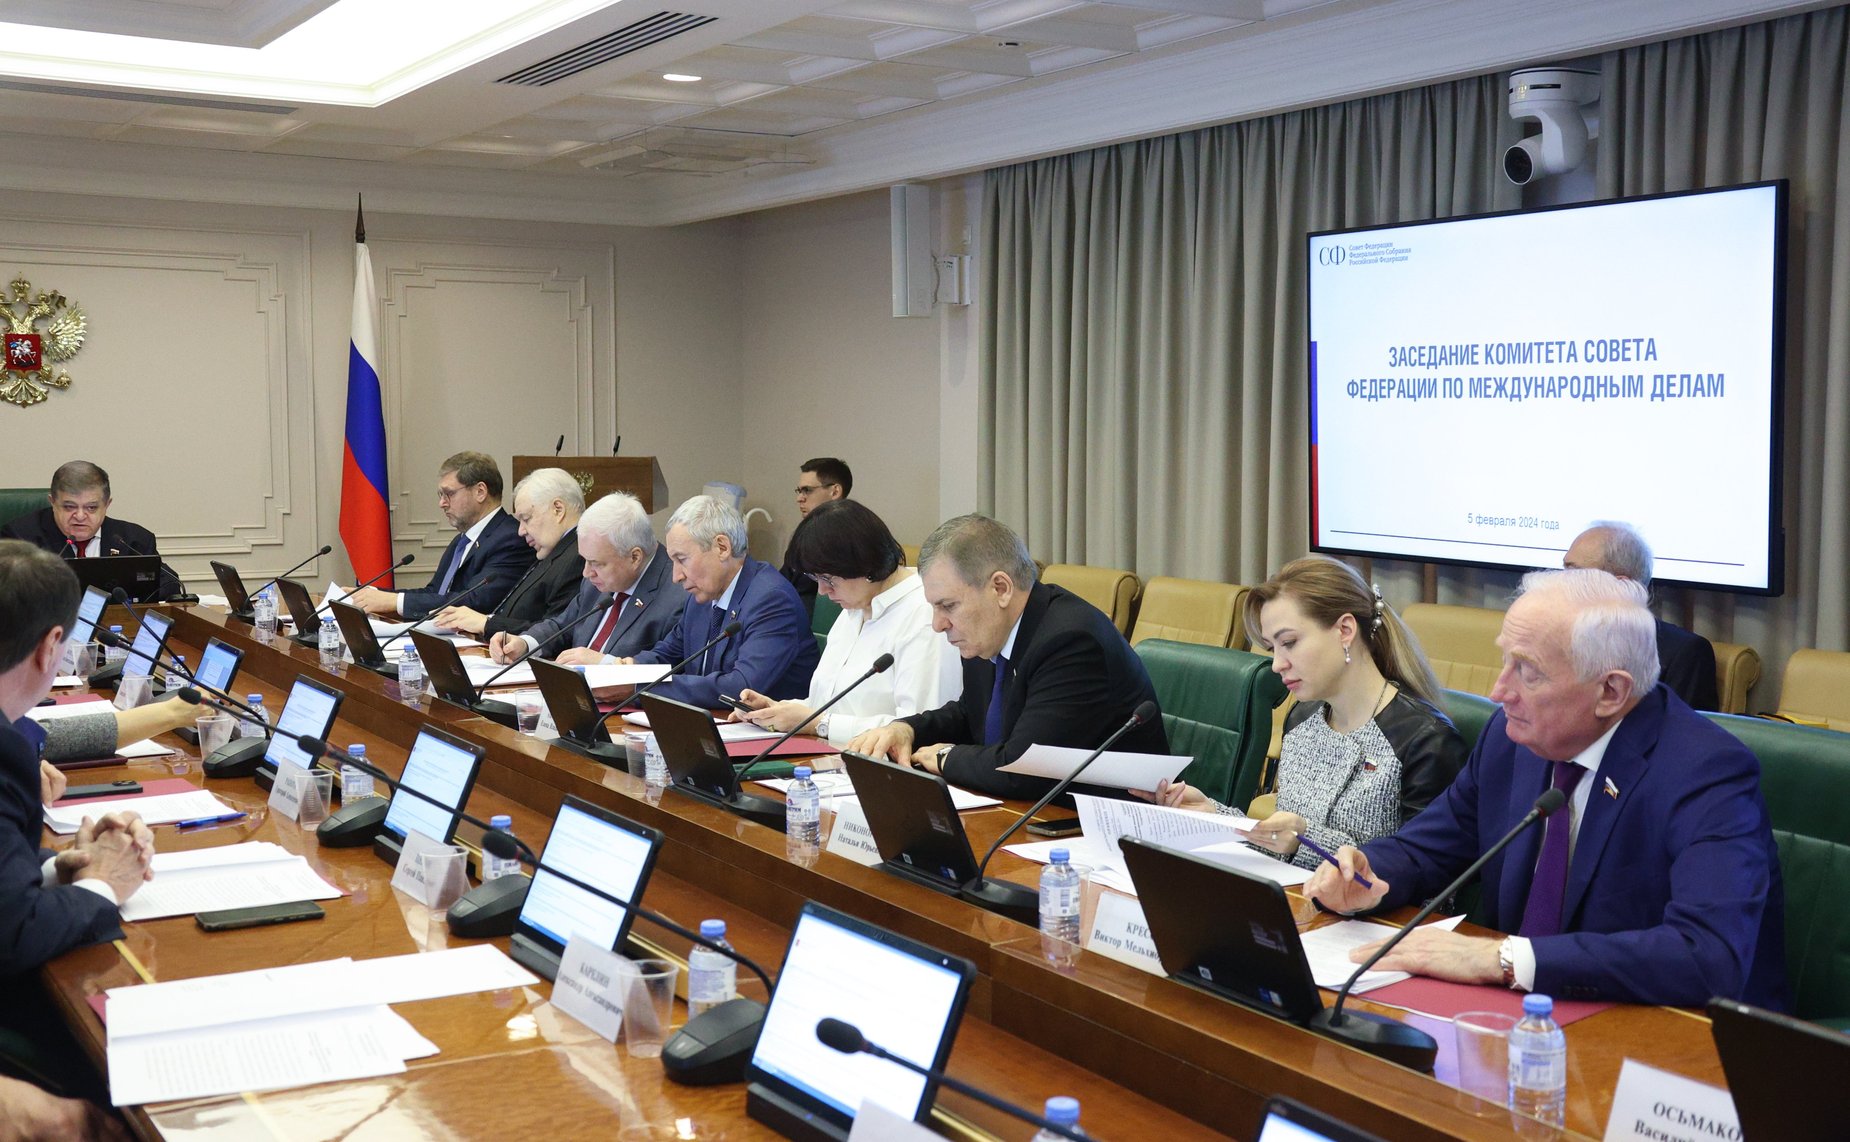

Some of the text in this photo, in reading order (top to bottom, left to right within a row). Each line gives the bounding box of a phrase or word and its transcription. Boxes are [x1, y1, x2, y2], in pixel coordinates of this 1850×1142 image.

[1319, 245, 1346, 266] СФ
[1364, 242, 1393, 250] Федерации
[1388, 338, 1658, 370] ЗАСЕДАНИЕ КОМИТЕТА СОВЕТА
[1346, 373, 1724, 402] ФЕДЕРАЦИИ ПО МЕЖДУНАРОДНЫМ ДЕЛАМ
[1467, 512, 1560, 530] 5 февраля 2024 года
[843, 821, 872, 838] НИКОНО
[837, 833, 880, 854] Наталья Юрье
[1094, 929, 1161, 963] Виктор Мельхио
[1653, 1101, 1741, 1142] ОСЬМАКО
